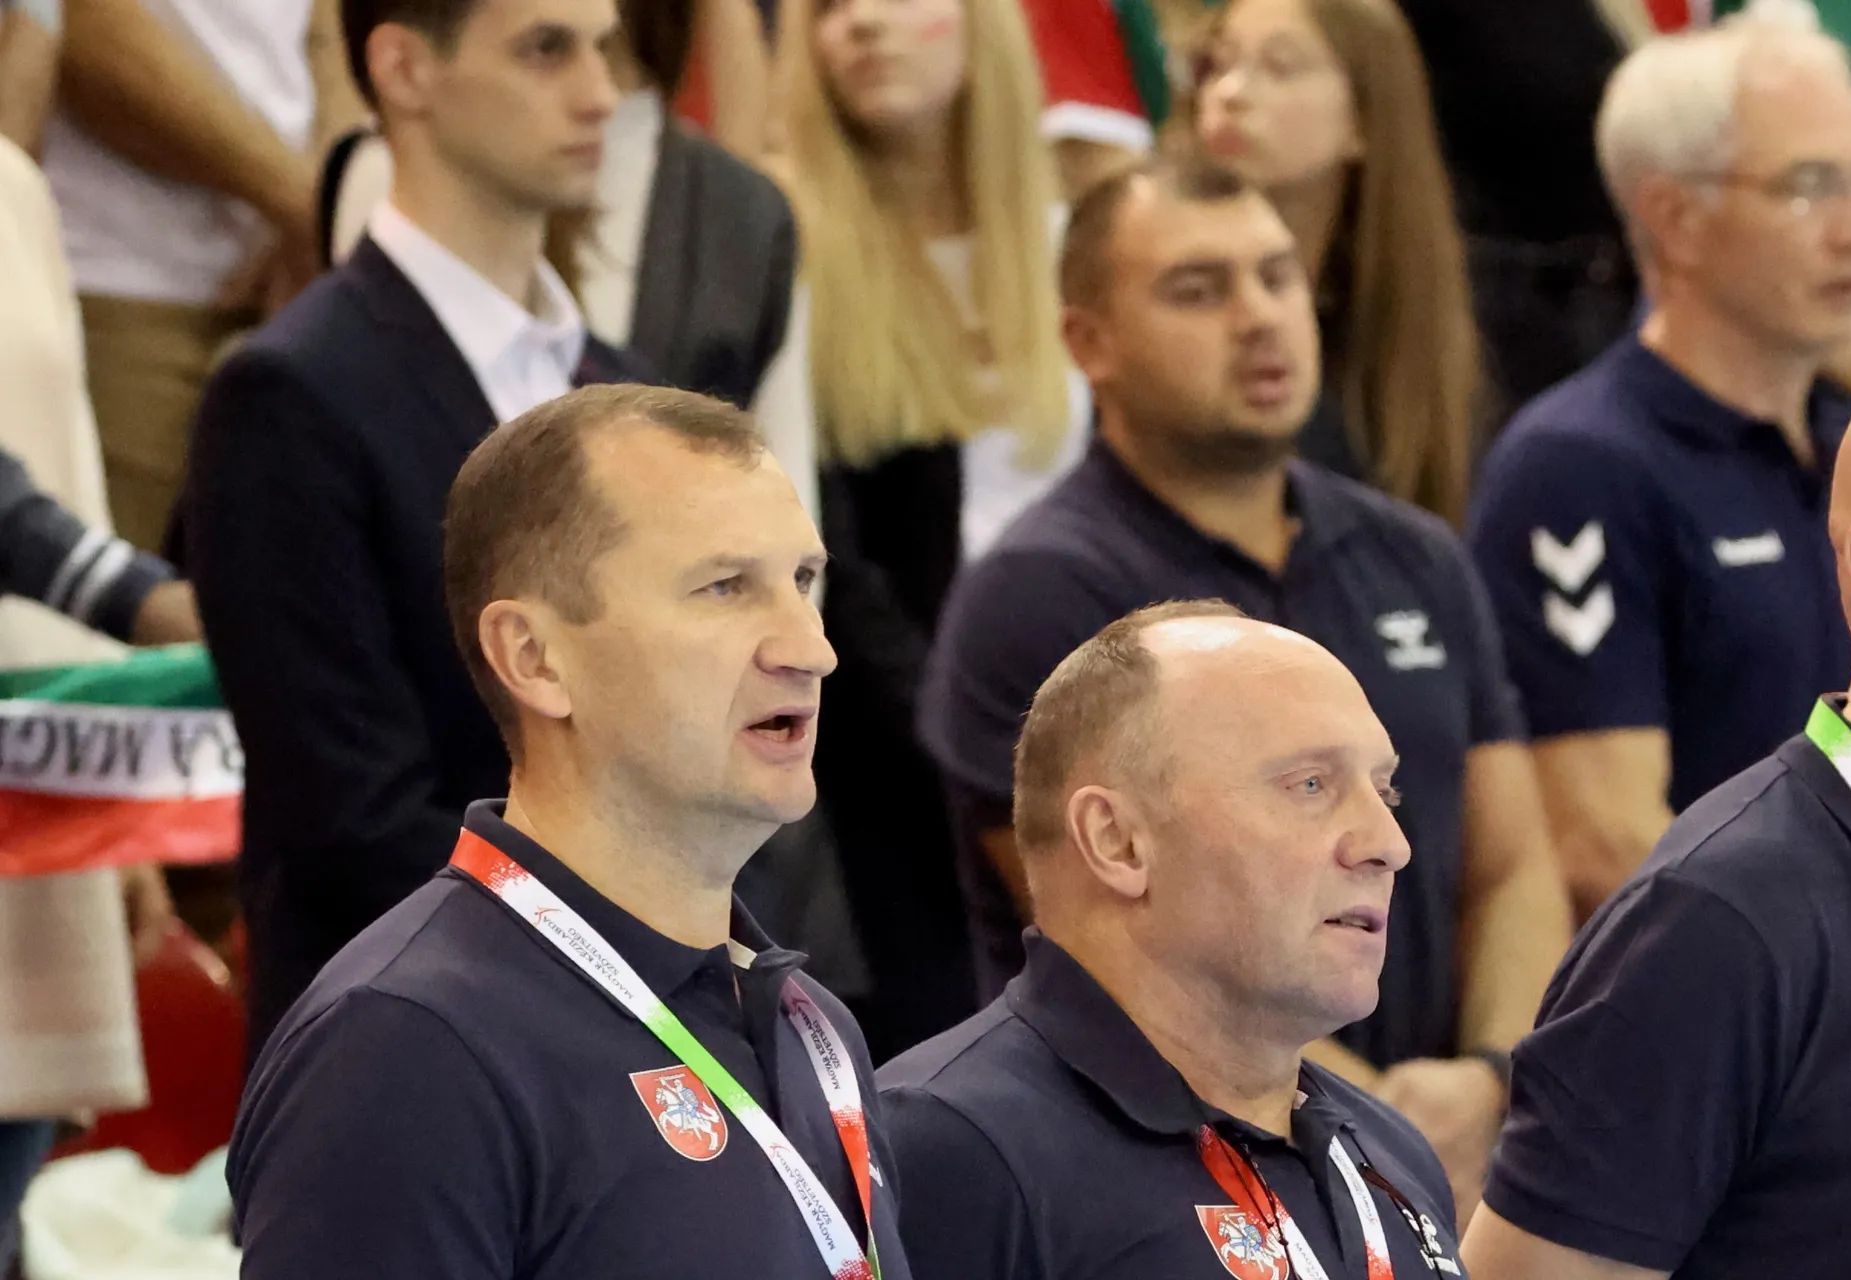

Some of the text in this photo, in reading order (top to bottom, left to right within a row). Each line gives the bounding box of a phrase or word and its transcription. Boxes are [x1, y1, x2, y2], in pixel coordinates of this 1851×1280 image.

[542, 915, 635, 1000] MAGYAR KÉZILABDA
[567, 927, 620, 977] SZÖVETSÉG
[822, 1055, 842, 1090] MAGYAR
[776, 1150, 836, 1252] MAGYAR KÉZILABDA
[793, 1167, 833, 1225] SZÖVETSÉG
